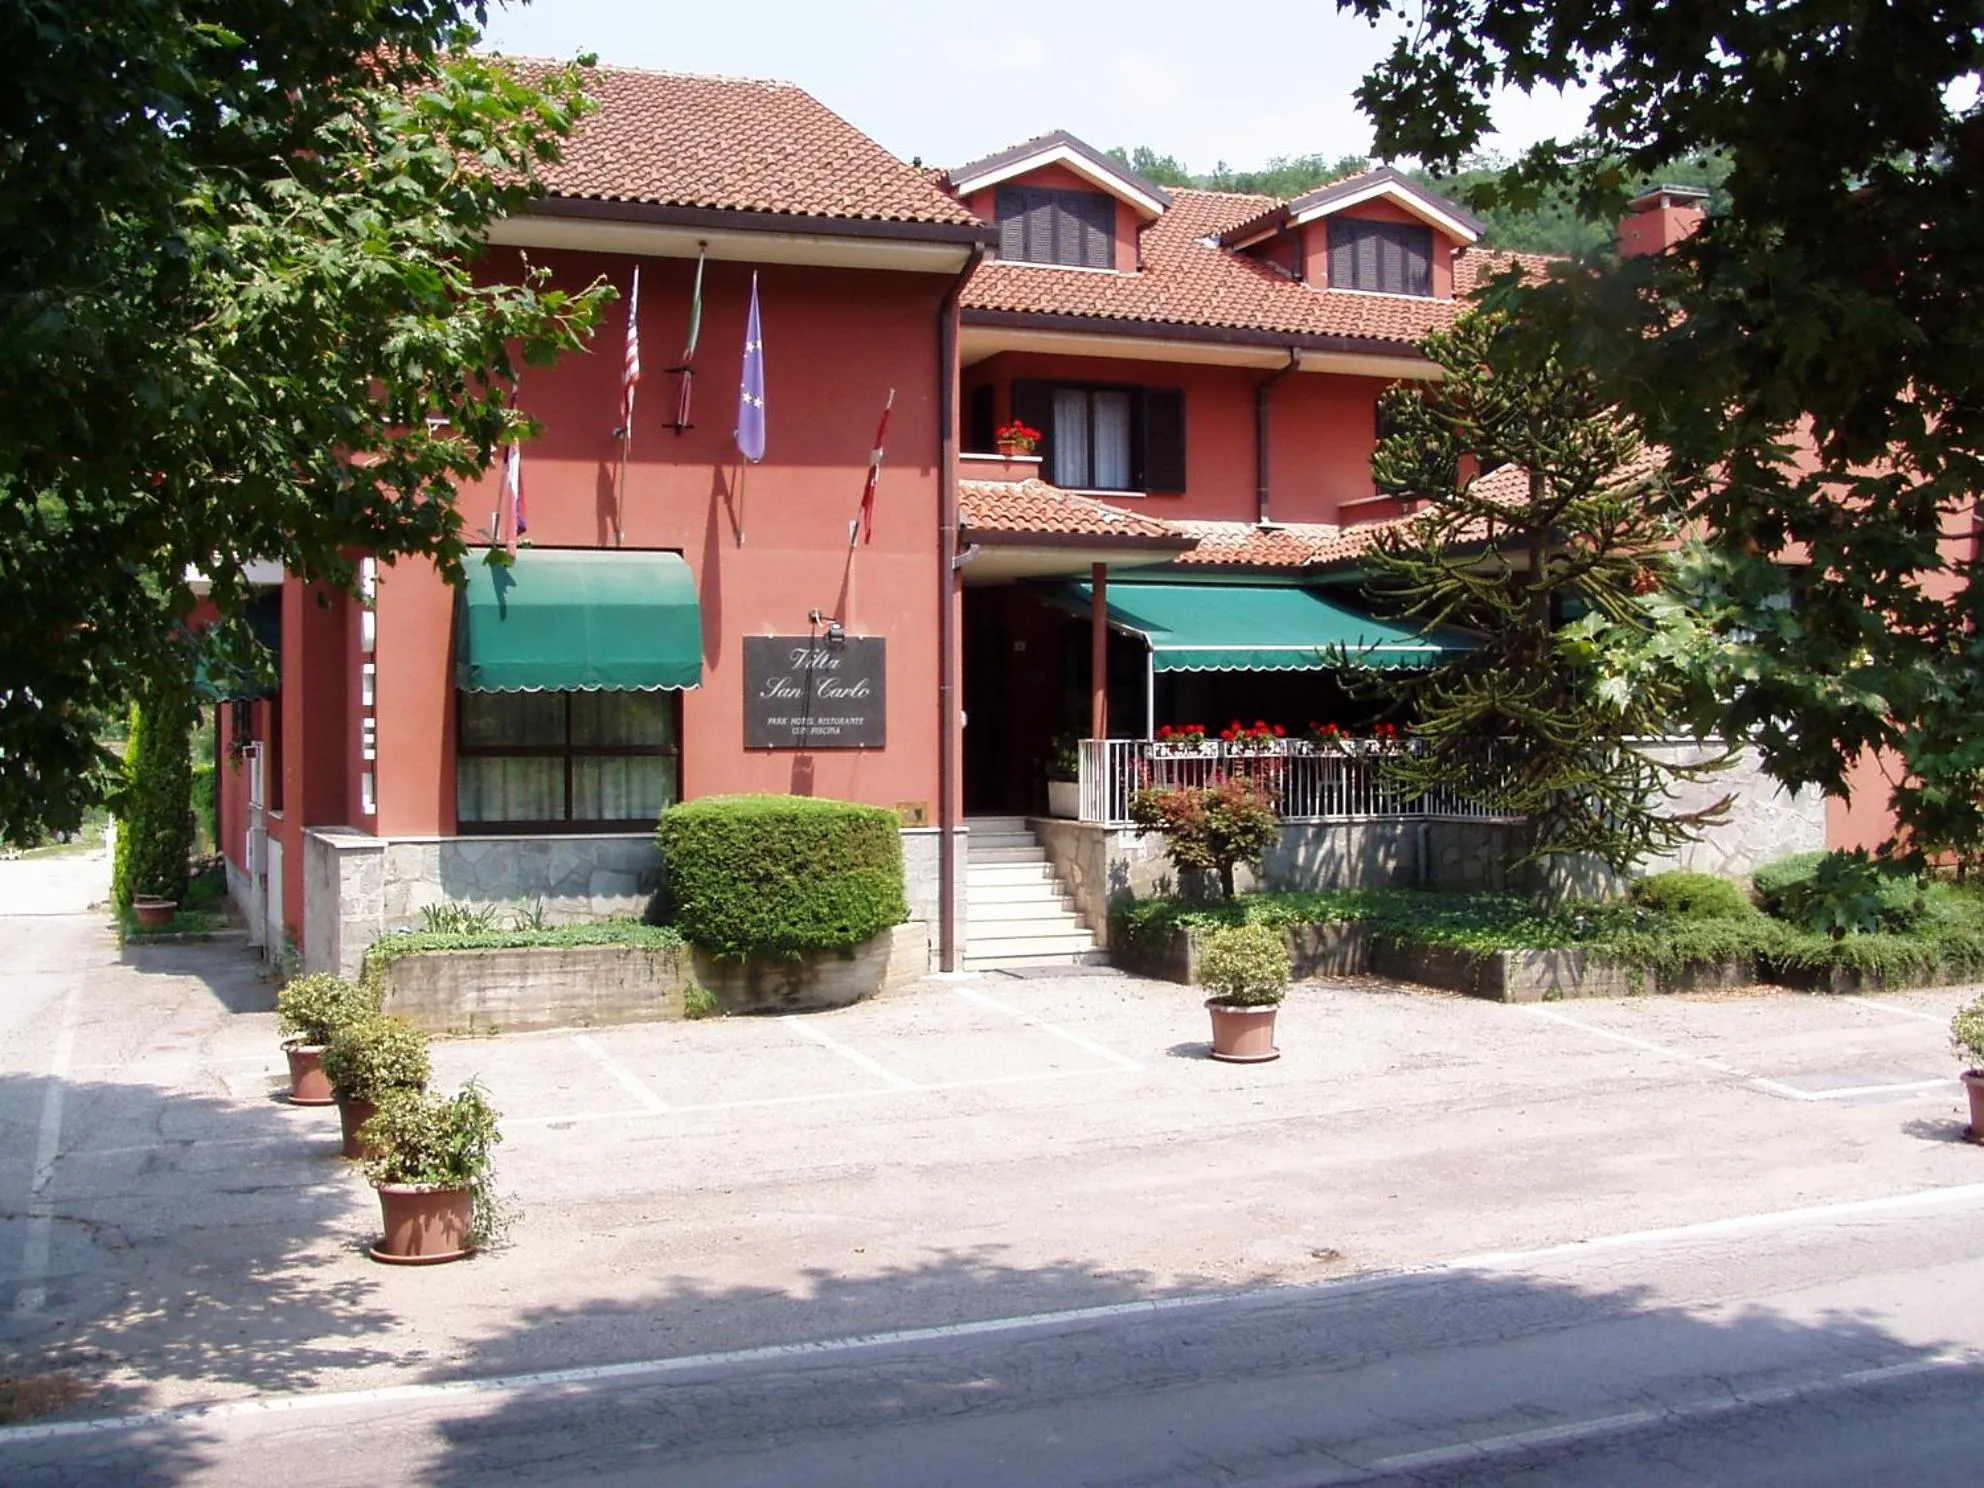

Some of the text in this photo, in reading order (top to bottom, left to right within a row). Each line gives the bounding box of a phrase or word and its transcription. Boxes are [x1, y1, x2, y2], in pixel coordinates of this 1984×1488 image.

[789, 648, 841, 669] Villa
[760, 677, 870, 698] San Carlo
[790, 717, 814, 725] HOTEL
[818, 717, 864, 725] RISTORANTE
